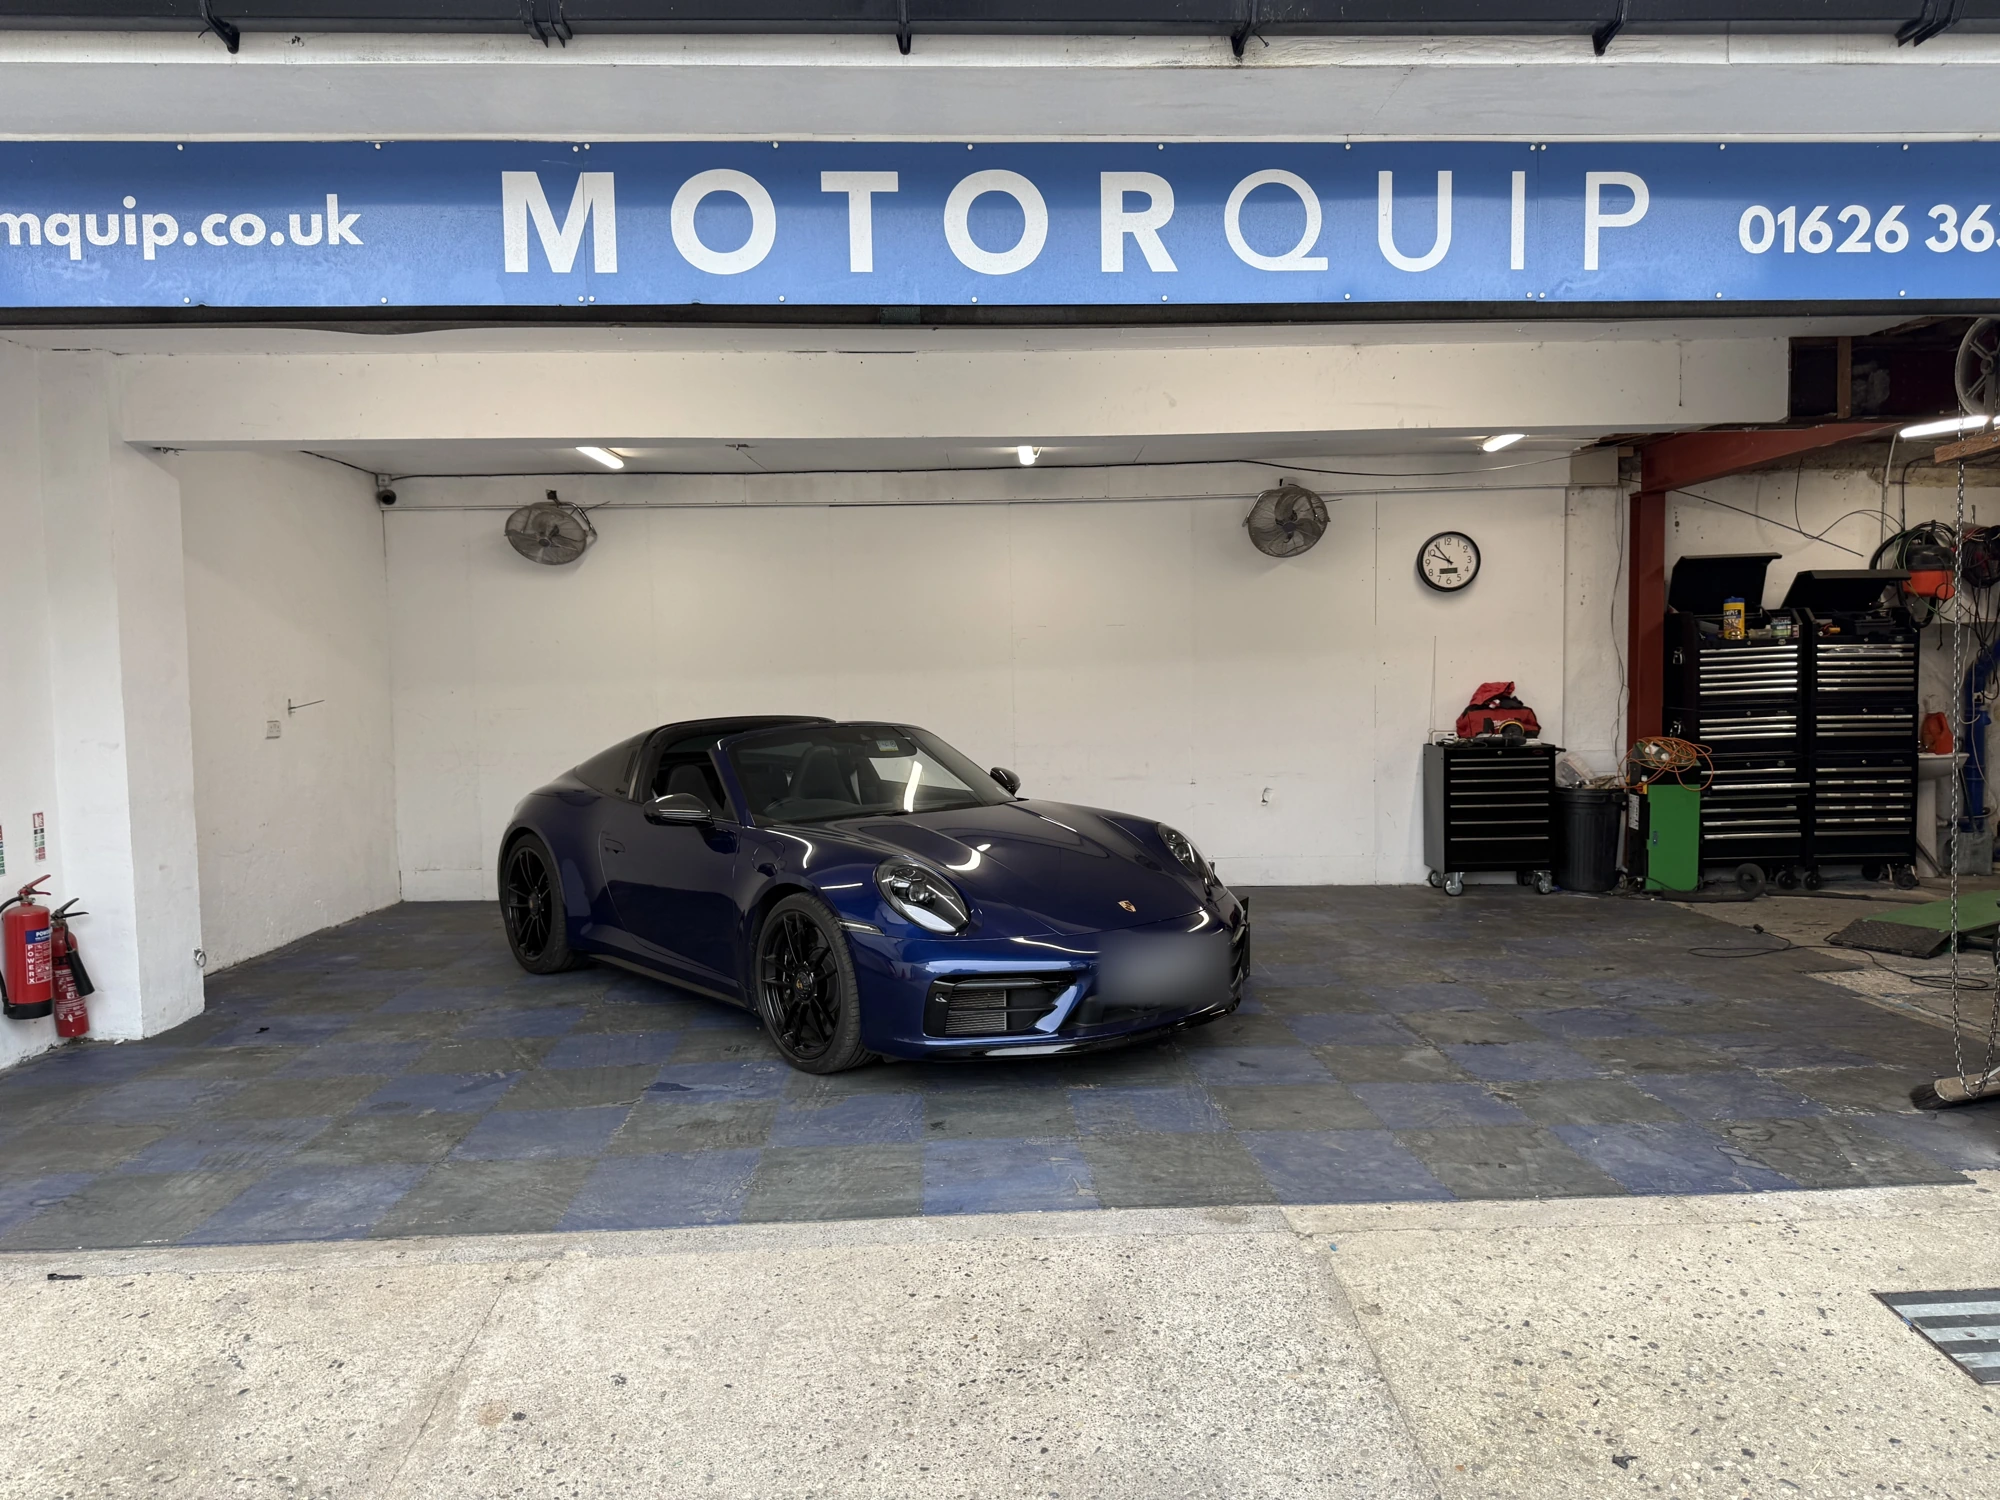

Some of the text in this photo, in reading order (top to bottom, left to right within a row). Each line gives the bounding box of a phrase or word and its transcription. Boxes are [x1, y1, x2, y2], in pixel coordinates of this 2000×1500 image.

[0, 193, 364, 261] mquip.co.uk
[502, 168, 1650, 275] MOTORQUIP
[1738, 203, 2000, 254] 01626 36
